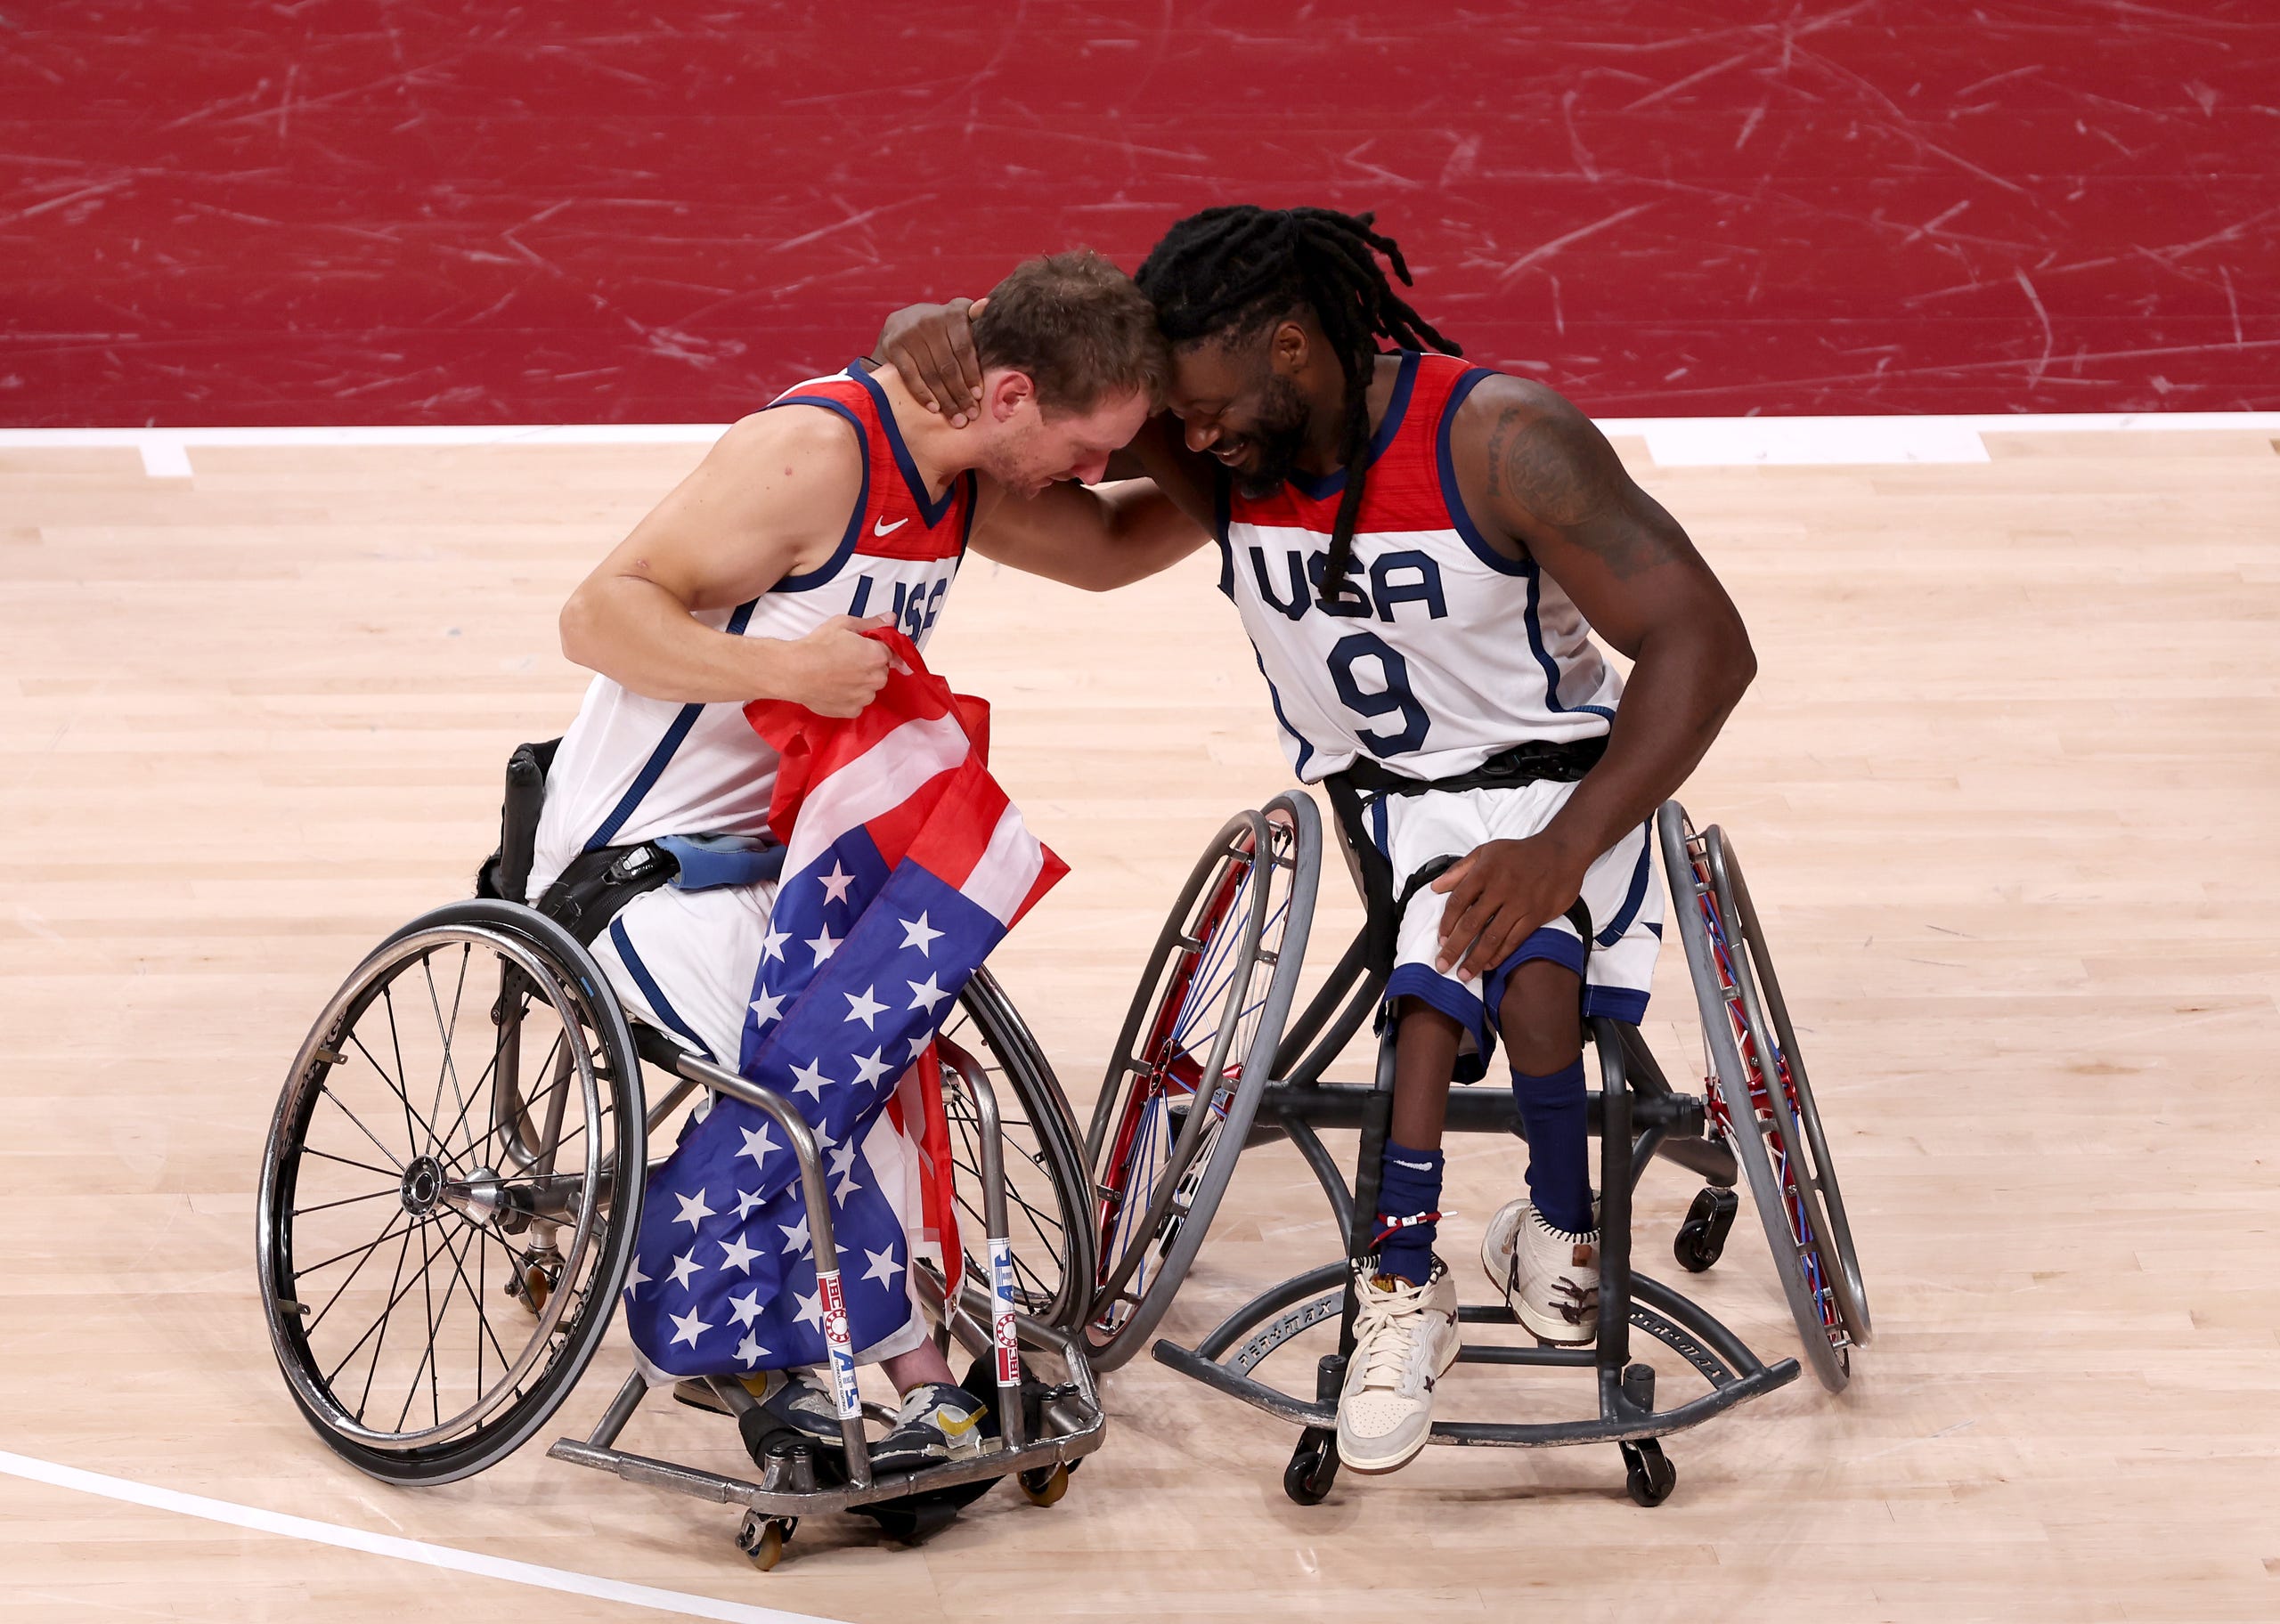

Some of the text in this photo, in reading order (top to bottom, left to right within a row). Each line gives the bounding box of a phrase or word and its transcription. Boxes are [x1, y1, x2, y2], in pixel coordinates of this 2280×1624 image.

[1249, 547, 1449, 622] USA
[1327, 631, 1430, 759] 9
[828, 1278, 843, 1310] IBC
